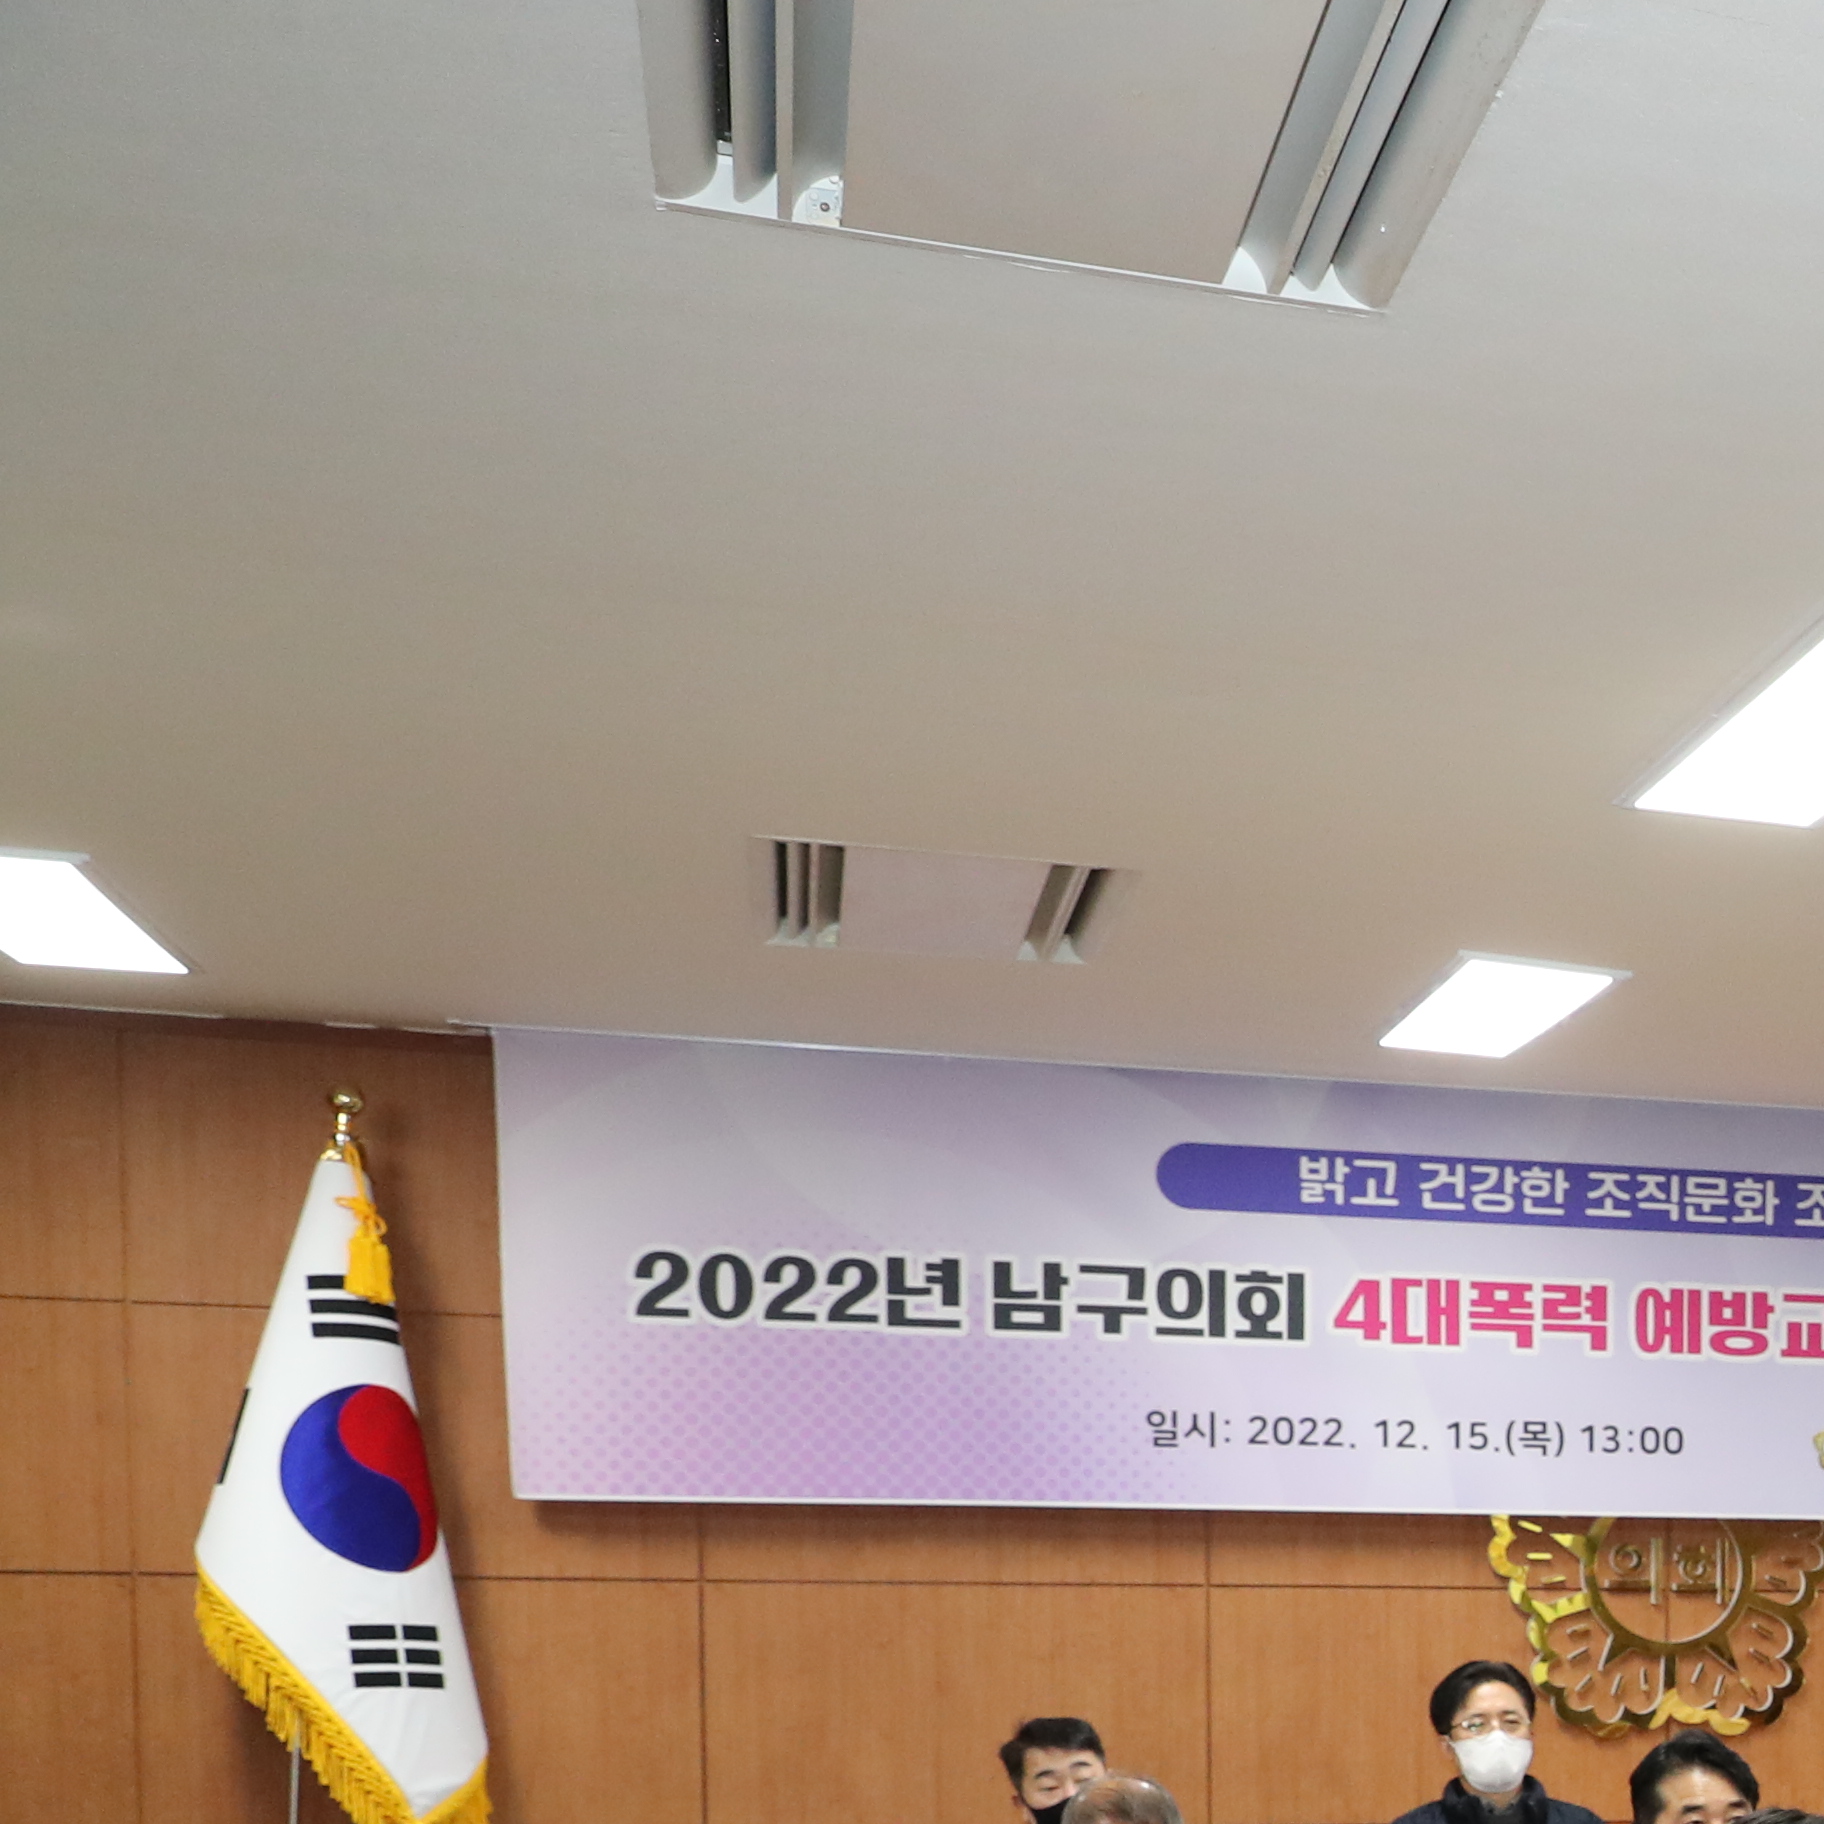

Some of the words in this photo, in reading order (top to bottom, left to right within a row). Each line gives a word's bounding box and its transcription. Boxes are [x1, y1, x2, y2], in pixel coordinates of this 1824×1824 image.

[1298, 1155, 1397, 1207] 밝고
[1418, 1161, 1570, 1216] 건강한
[1585, 1169, 1780, 1228] 조직문화
[634, 1249, 962, 1330] 2022년
[991, 1260, 1306, 1343] 남구의회
[1333, 1276, 1609, 1354] 4대폭력
[1146, 1410, 1232, 1449] 일시:
[1246, 1415, 1356, 1450] 2022.
[1375, 1419, 1429, 1452] 12.
[1446, 1420, 1566, 1459] 15.(목)
[1581, 1424, 1685, 1457] 13:00
[1604, 1536, 1730, 1606] 의회
